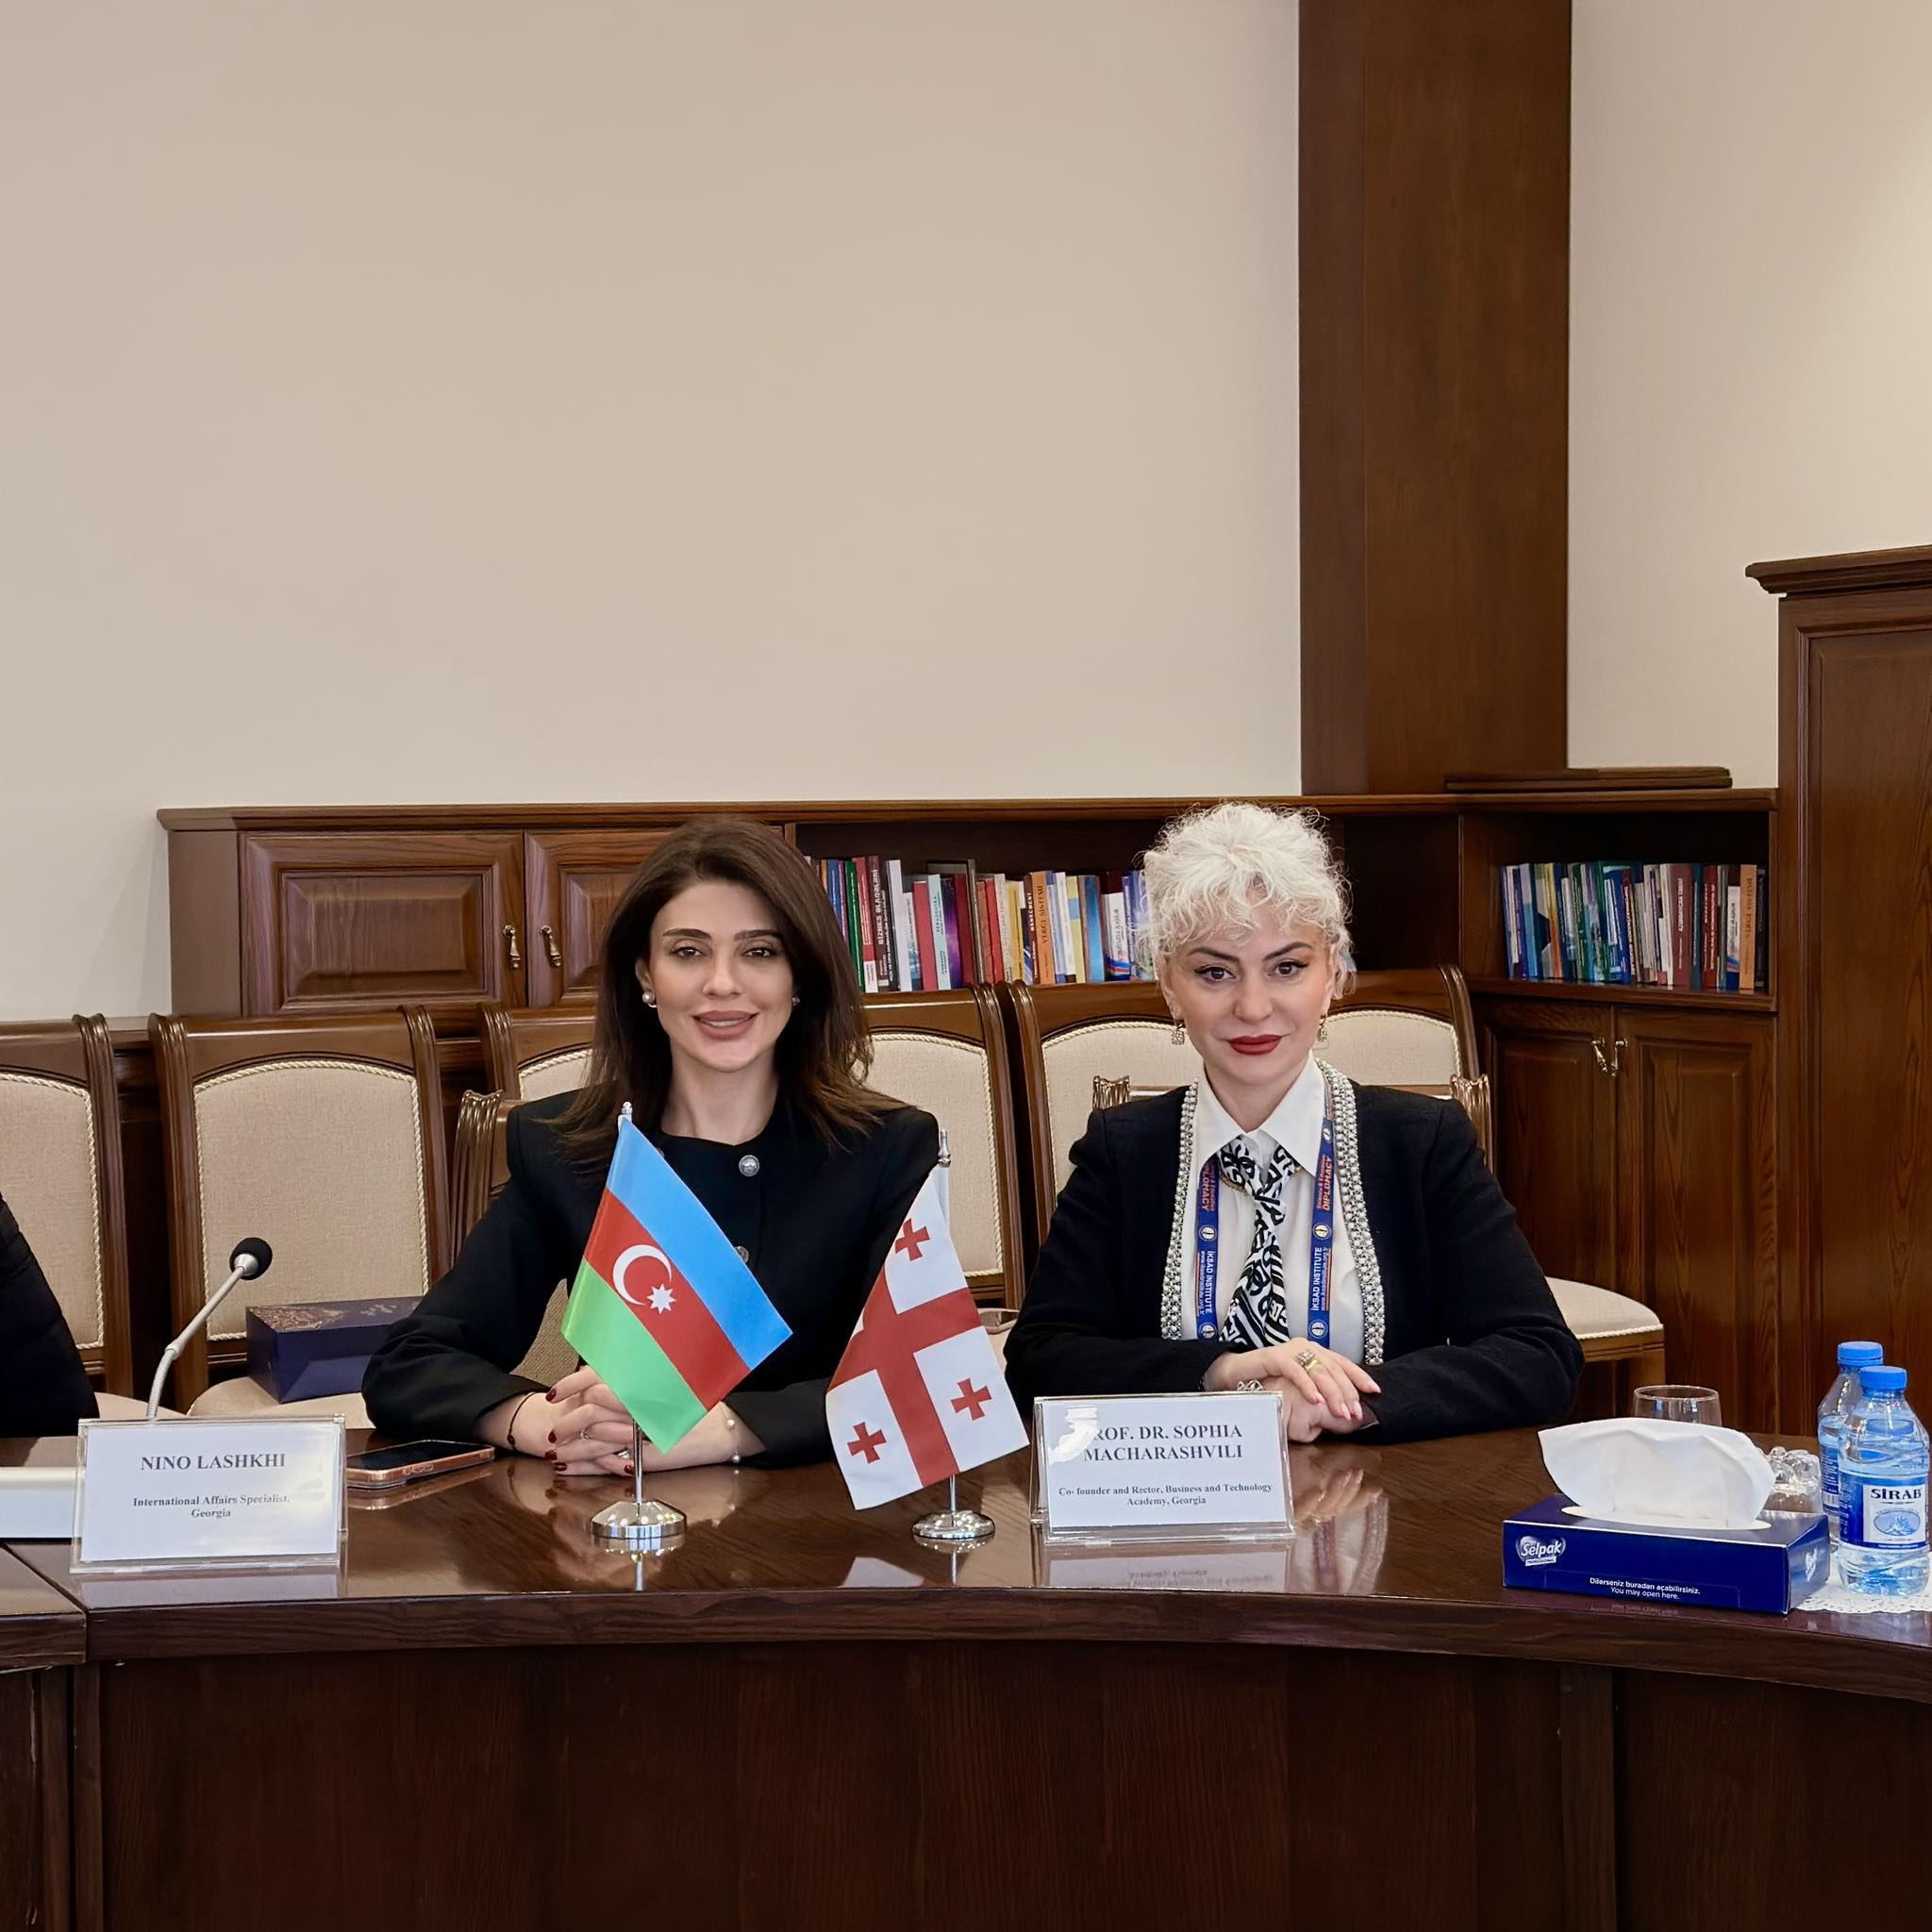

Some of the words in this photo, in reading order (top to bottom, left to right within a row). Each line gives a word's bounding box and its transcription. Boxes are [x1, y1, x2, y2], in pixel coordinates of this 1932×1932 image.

[1323, 1156, 1332, 1211] DIPLOMACY
[1312, 1247, 1323, 1285] INSTITUTE
[1204, 1274, 1214, 1314] INSTITUTE
[1093, 1426, 1134, 1441] ROF.
[1140, 1425, 1169, 1440] DR.
[1174, 1424, 1242, 1439] SOPHIA
[1084, 1444, 1242, 1461] MACHARASHVILI
[141, 1455, 192, 1471] NINO
[197, 1453, 286, 1470] LASHKHI
[1058, 1487, 1074, 1495] Co-
[1076, 1487, 1111, 1495] founder
[1113, 1486, 1129, 1495] and
[1132, 1486, 1164, 1495] Rector,
[1165, 1485, 1203, 1493] Business
[1204, 1484, 1221, 1492] and
[1223, 1483, 1272, 1493] Technology
[133, 1496, 199, 1507] International
[202, 1494, 238, 1506] Affairs
[1127, 1497, 1170, 1507] Academy,
[1171, 1495, 1207, 1506] Georgia
[191, 1507, 231, 1519] Georgia
[1520, 1541, 1562, 1558] Selpak
[1590, 1577, 1624, 1587] Dilerseniz
[1625, 1581, 1655, 1591] buradan
[1656, 1585, 1701, 1595] açabilirsiniz.
[1625, 1589, 1641, 1597] may
[1641, 1591, 1660, 1599] open
[1661, 1591, 1680, 1600] here.
